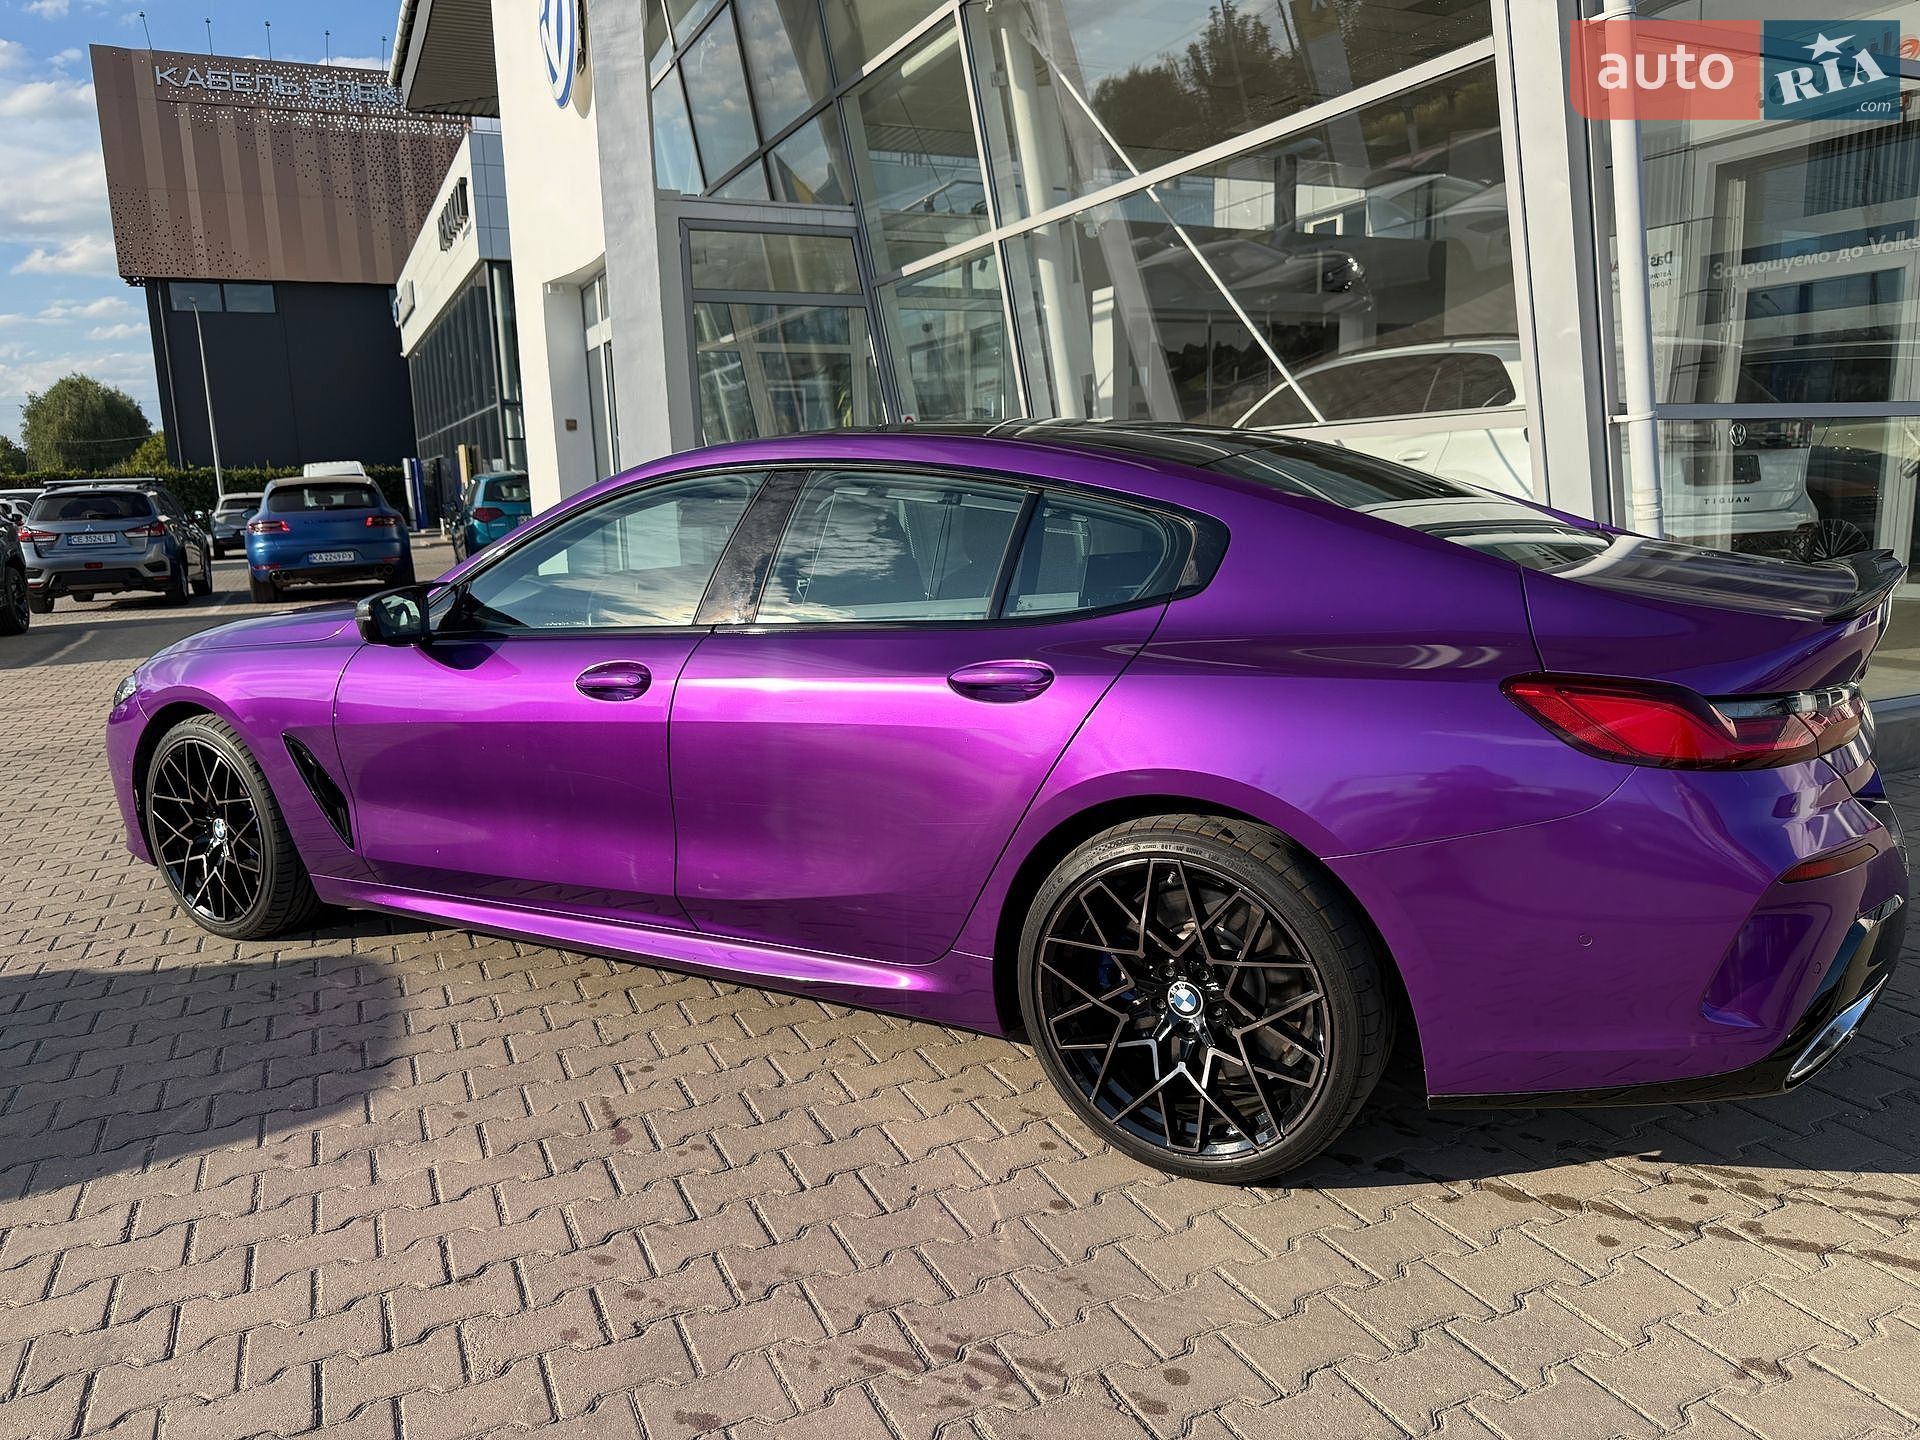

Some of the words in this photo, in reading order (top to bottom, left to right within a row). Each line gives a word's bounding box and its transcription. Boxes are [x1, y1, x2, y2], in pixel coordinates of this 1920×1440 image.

[155, 65, 300, 97] КАБЕЛЬ
[310, 79, 402, 105] ЕЛЕК
[1712, 250, 1830, 280] Запрошуємо
[1836, 245, 1864, 264] до
[1703, 496, 1750, 504] TIGUAN
